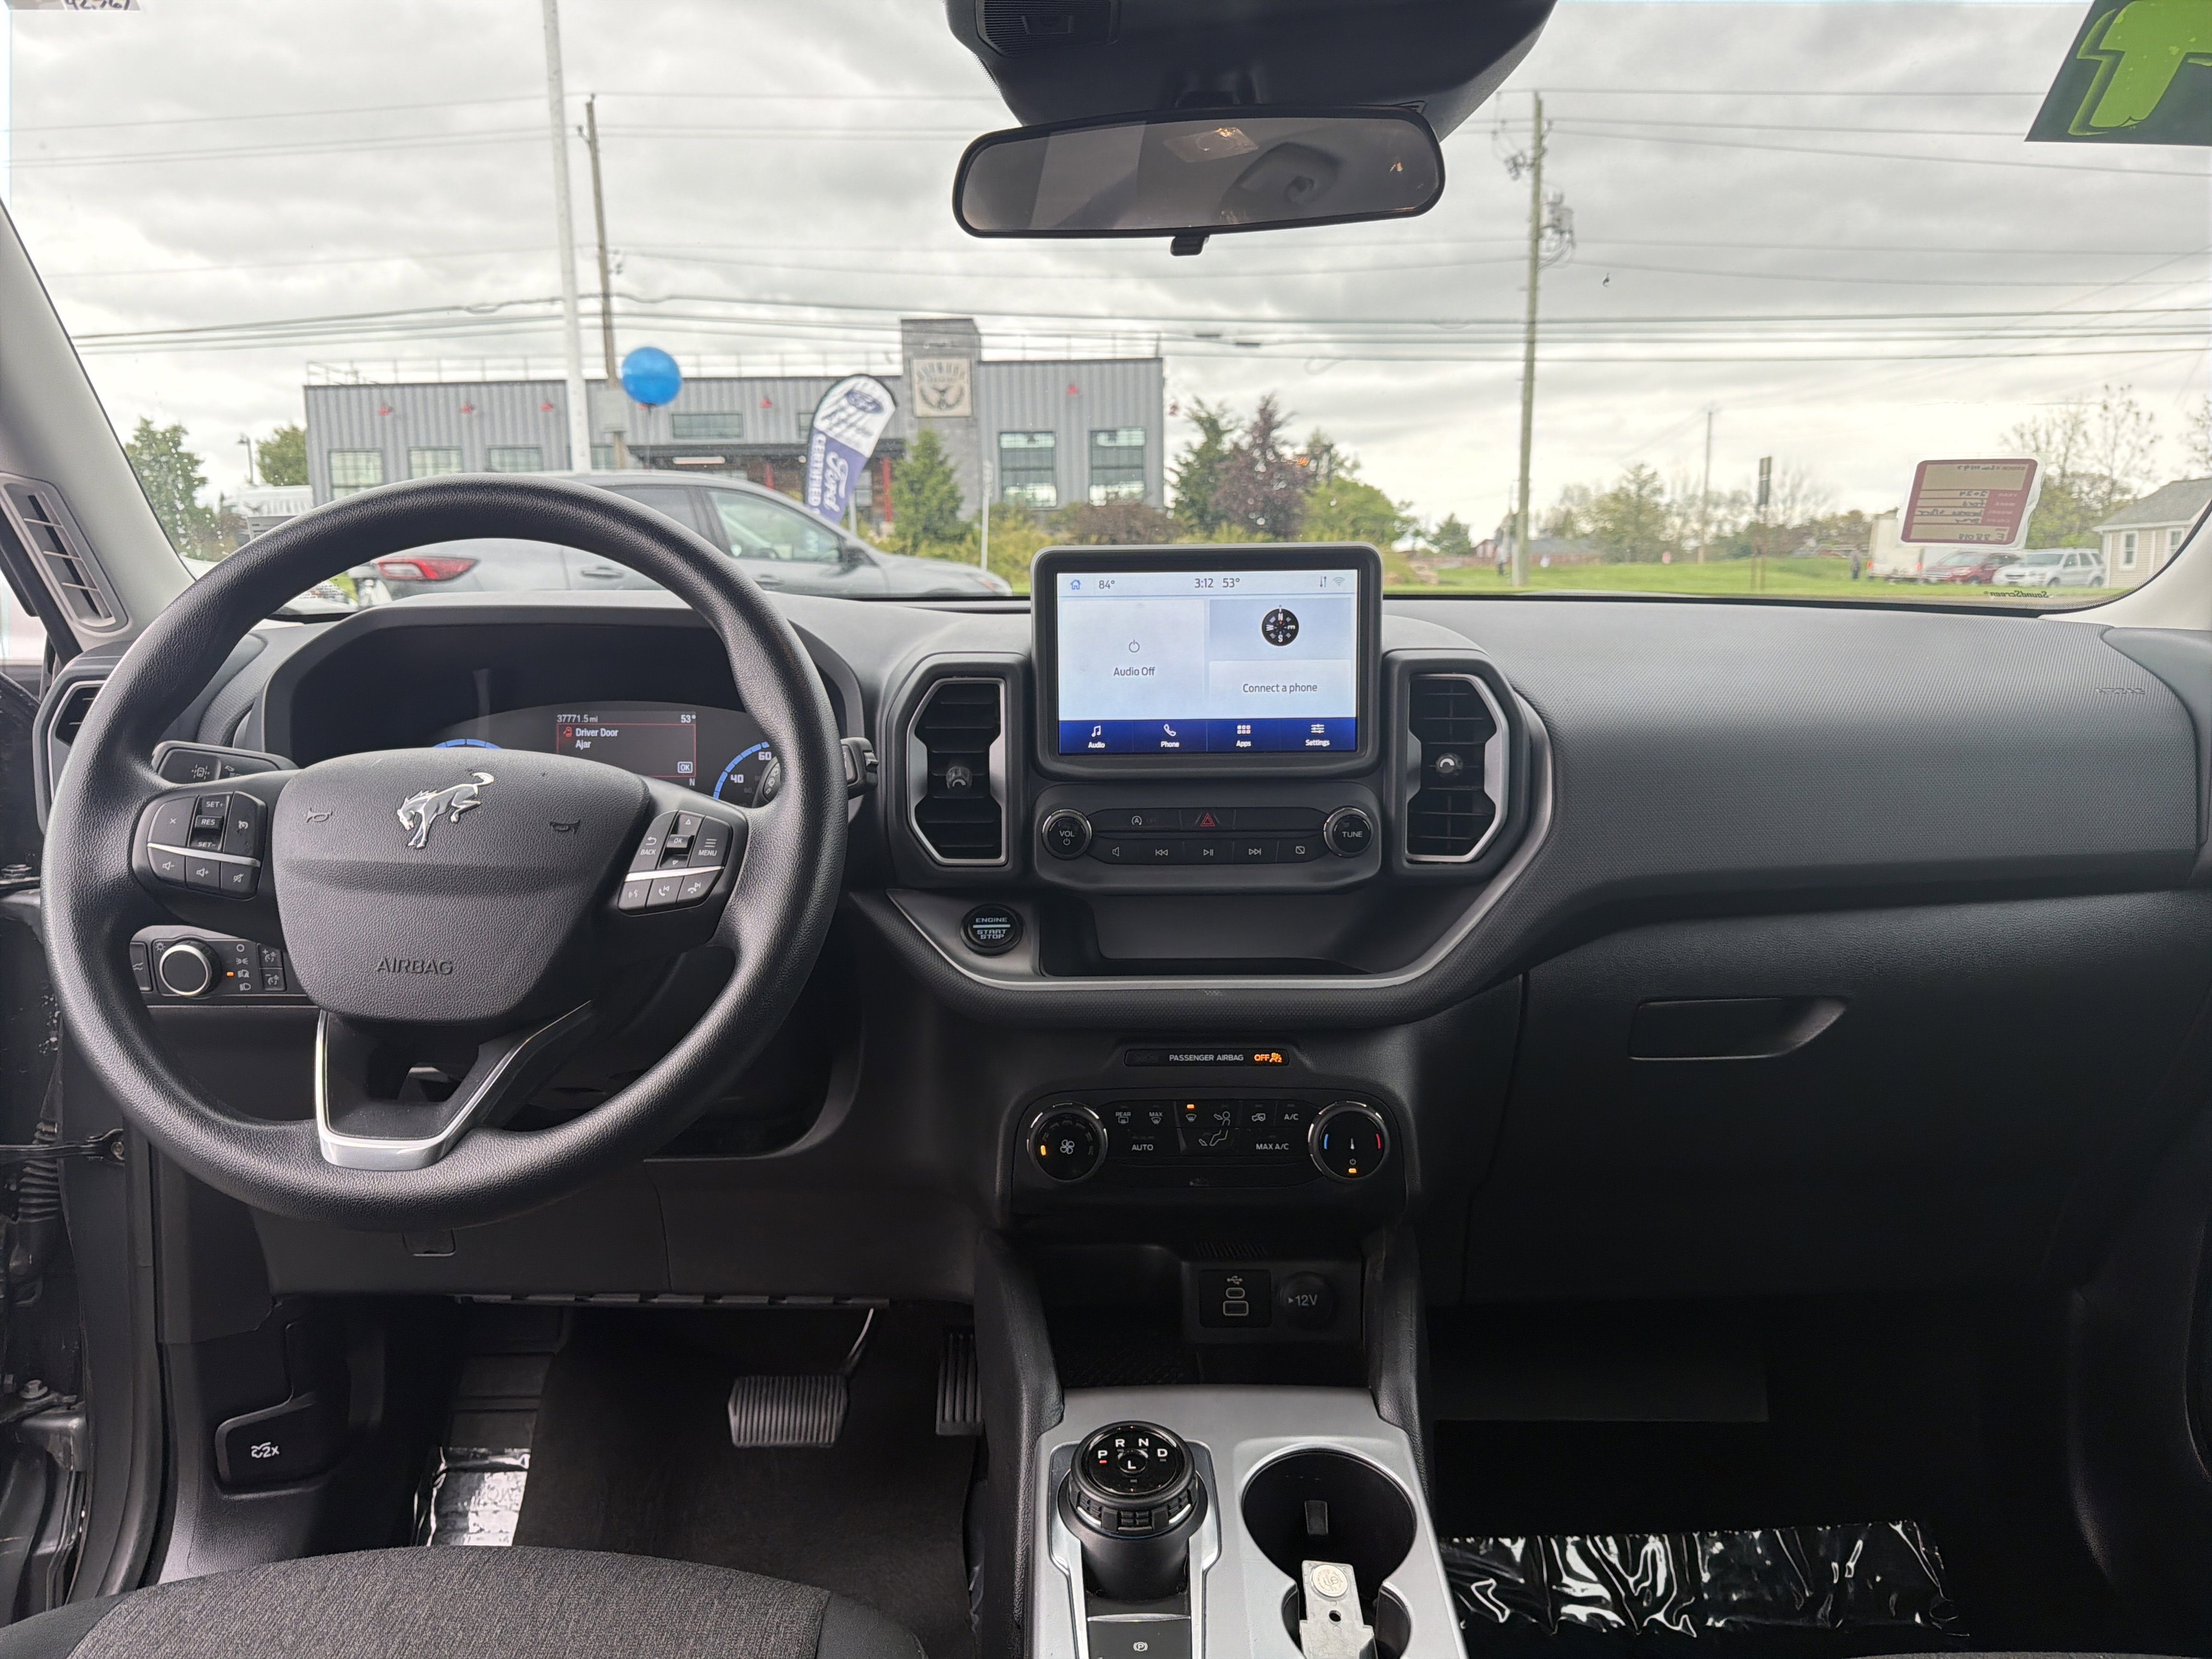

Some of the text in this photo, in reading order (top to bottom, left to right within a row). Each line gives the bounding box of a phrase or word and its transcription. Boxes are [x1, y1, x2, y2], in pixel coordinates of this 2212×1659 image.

[808, 433, 826, 506] CERTIFIED
[823, 452, 849, 512] Ford
[1098, 579, 1115, 590] 84°
[1194, 577, 1240, 589] 3:12 53°
[1113, 665, 1155, 677] Audio Off
[1243, 682, 1279, 693] Connect
[1289, 682, 1318, 695] phone
[557, 714, 599, 724] 37771.5 mi
[575, 727, 619, 737] Driver Door
[575, 740, 591, 750] Ajar
[1160, 740, 1180, 748] Phone
[1236, 740, 1251, 748] Apps
[1305, 738, 1330, 748] Settings
[758, 752, 772, 761] 60
[680, 763, 691, 771] OK
[689, 777, 696, 786] N
[730, 774, 744, 783] 40
[1059, 830, 1075, 838] VOL
[377, 957, 454, 975] AIRBAG
[1254, 1053, 1270, 1062] OFF
[1284, 1113, 1299, 1121] A/C
[1255, 1142, 1290, 1151] MAX A/C
[1295, 1294, 1318, 1307] 12V
[1115, 1438, 1125, 1447] R
[1138, 1438, 1149, 1447] N
[1098, 1449, 1108, 1459] P
[1157, 1448, 1168, 1458] D
[1127, 1460, 1136, 1470] L
